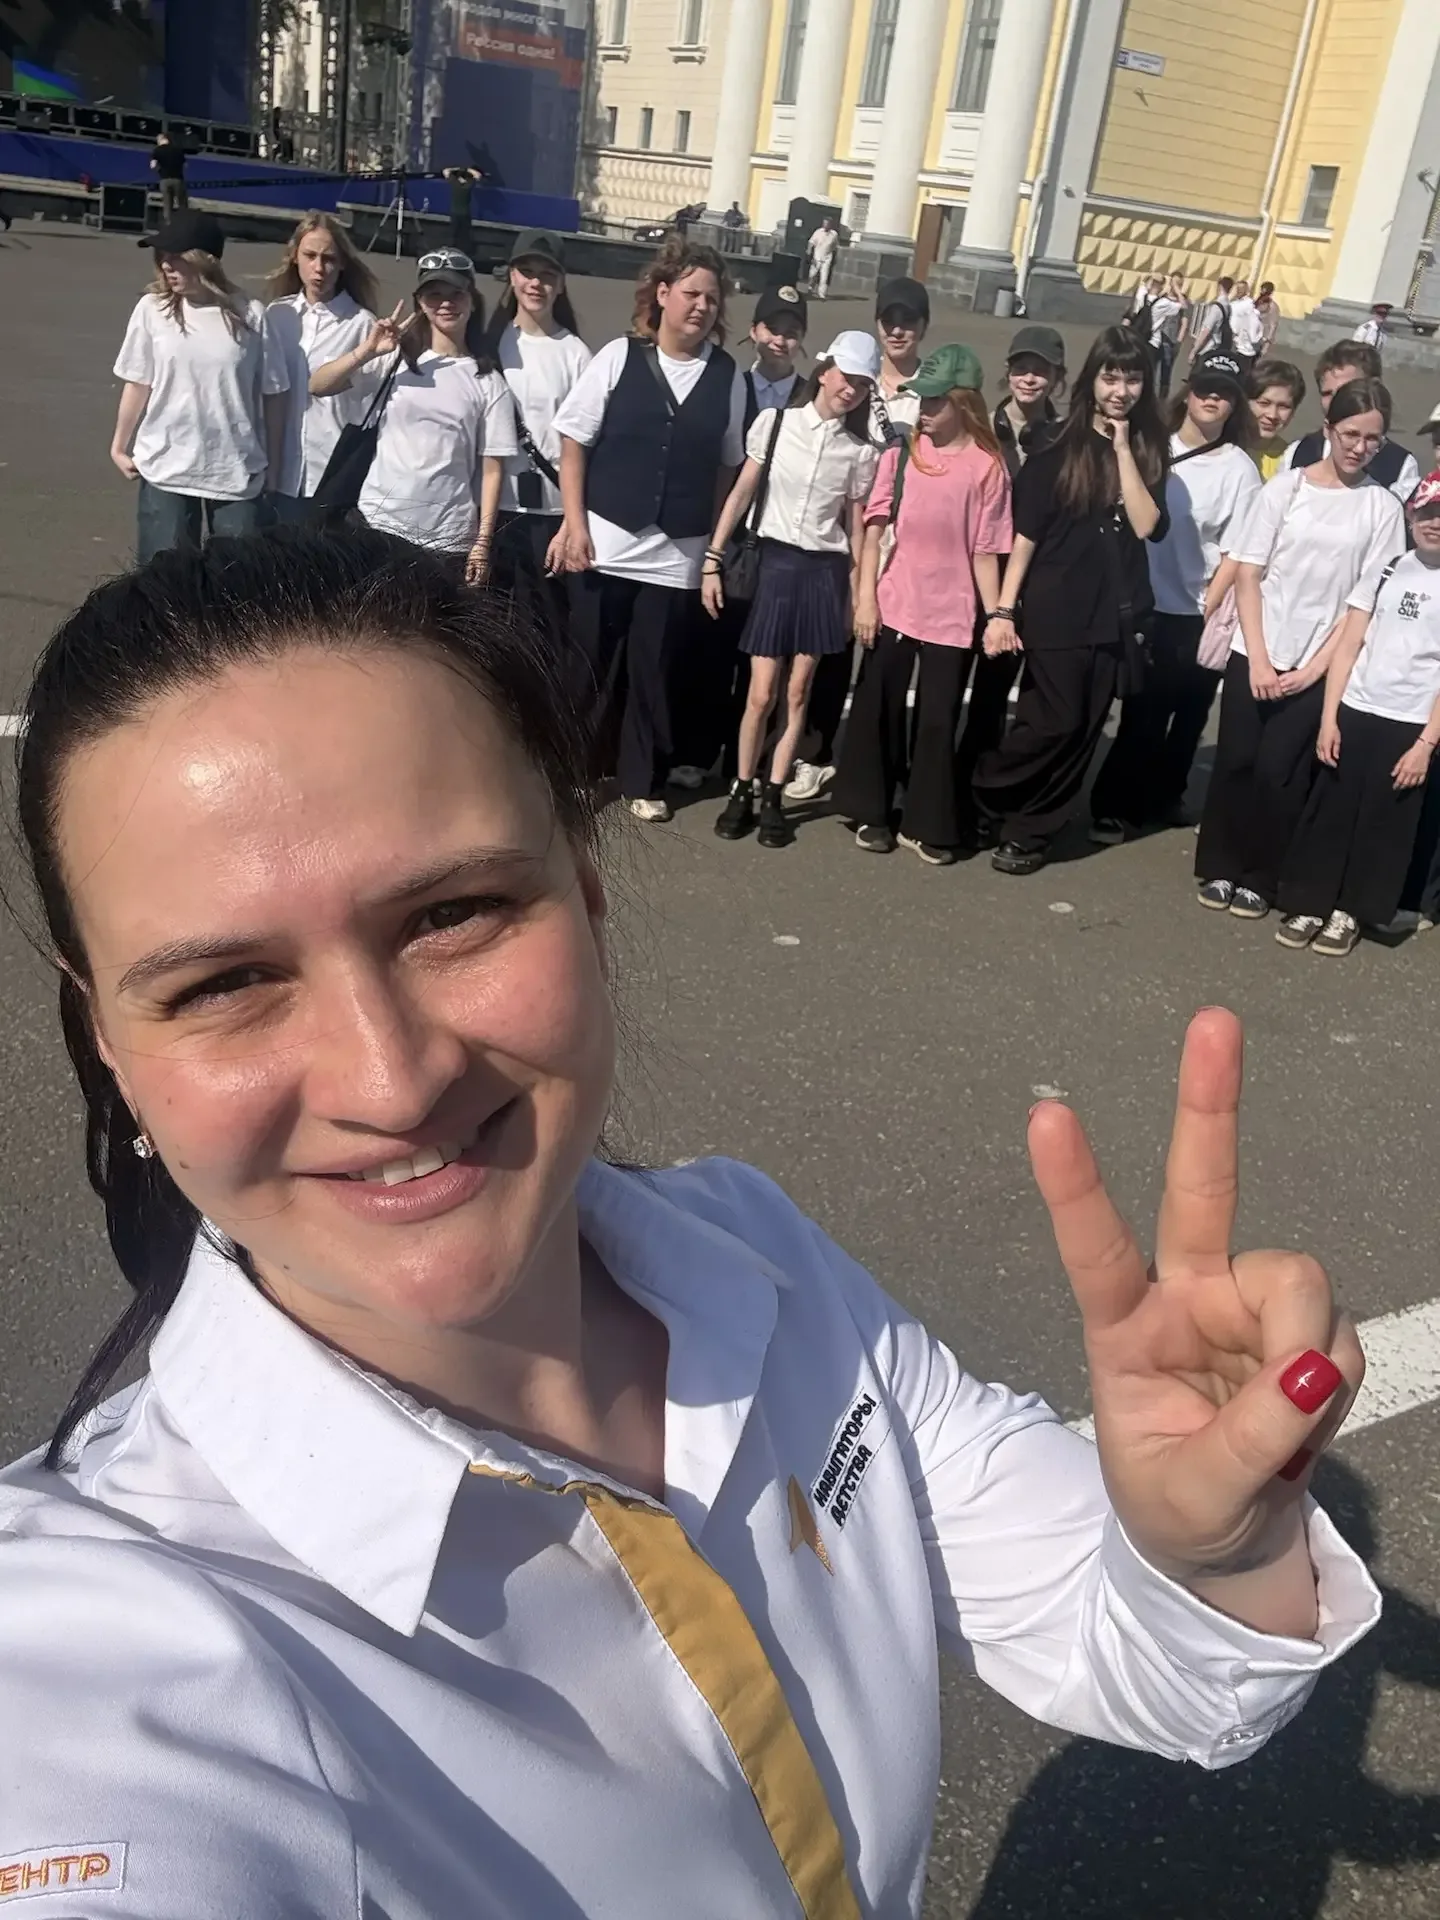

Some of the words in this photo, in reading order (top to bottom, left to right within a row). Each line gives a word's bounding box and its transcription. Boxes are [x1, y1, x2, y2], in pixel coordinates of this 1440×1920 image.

[466, 32, 515, 52] Россия
[1403, 591, 1418, 601] BE
[1400, 599, 1420, 610] UNI
[1397, 607, 1420, 620] QUE
[813, 1393, 877, 1508] НАВИГАТОРЫ
[830, 1444, 873, 1527] ДЕТСТВА
